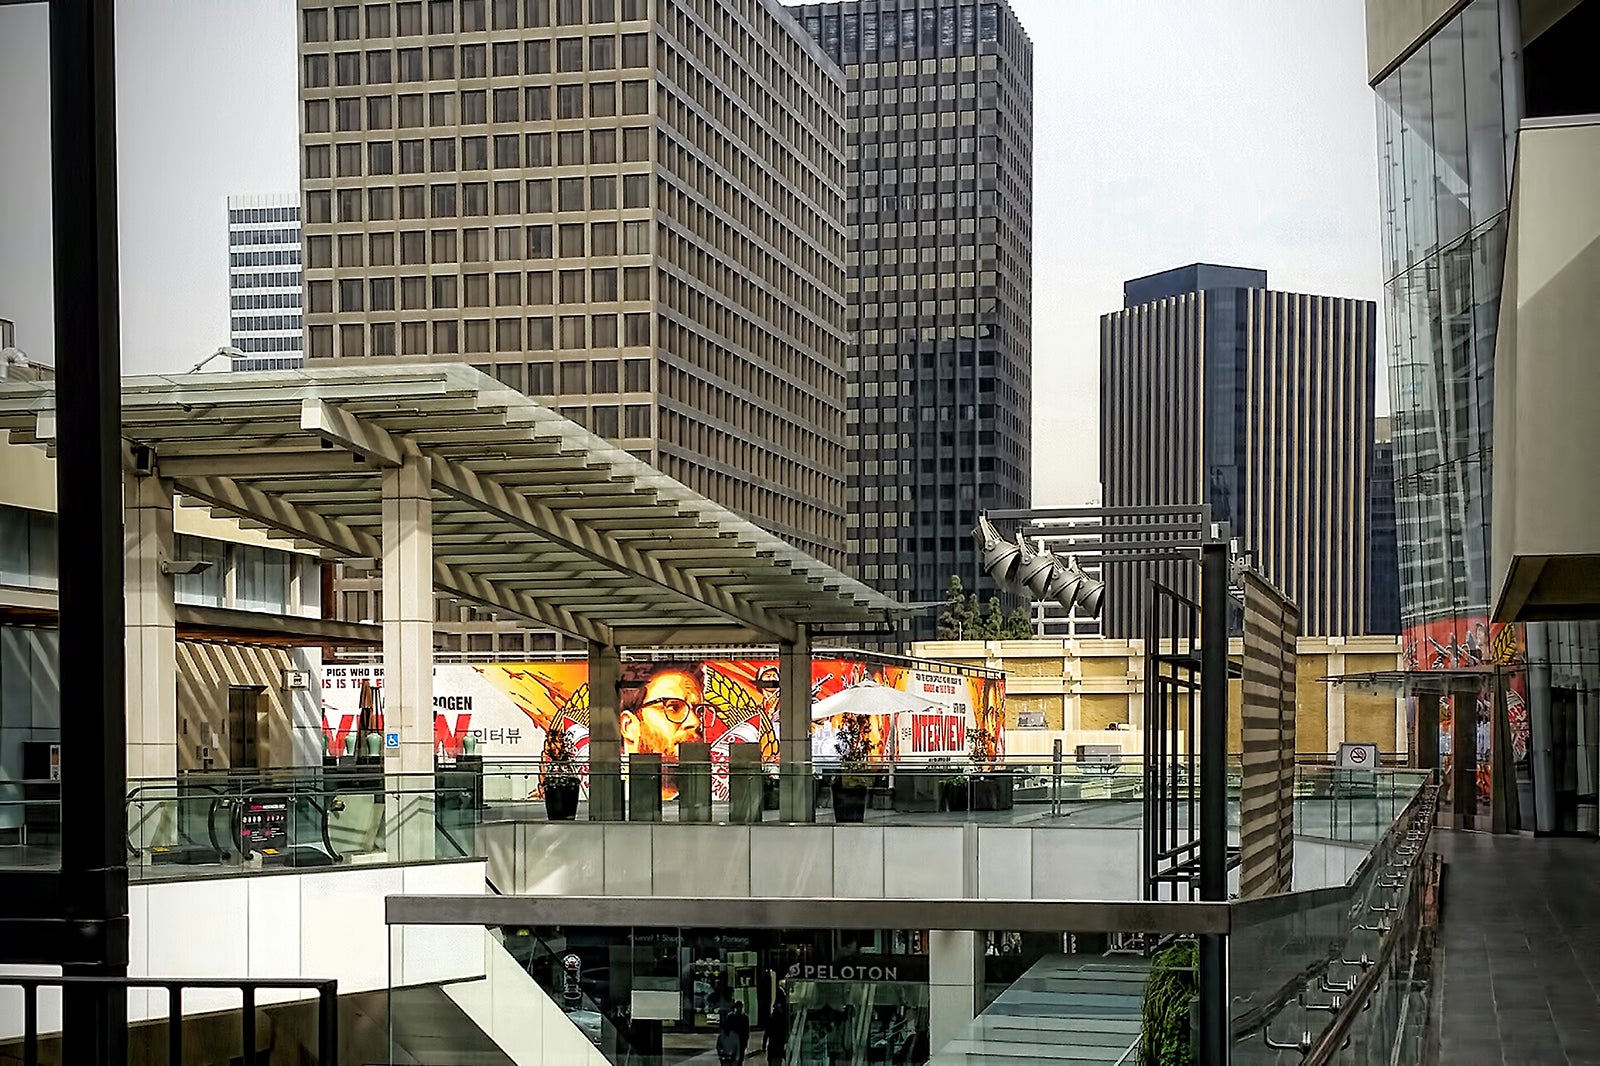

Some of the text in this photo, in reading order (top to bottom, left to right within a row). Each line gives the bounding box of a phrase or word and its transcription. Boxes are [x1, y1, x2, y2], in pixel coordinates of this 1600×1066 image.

[326, 668, 347, 677] PIGS
[350, 668, 370, 677] WHO
[336, 678, 347, 689] IS
[473, 727, 522, 745] 인터뷰
[911, 713, 966, 753] INTERVIEW
[804, 965, 898, 981] PELOTON
